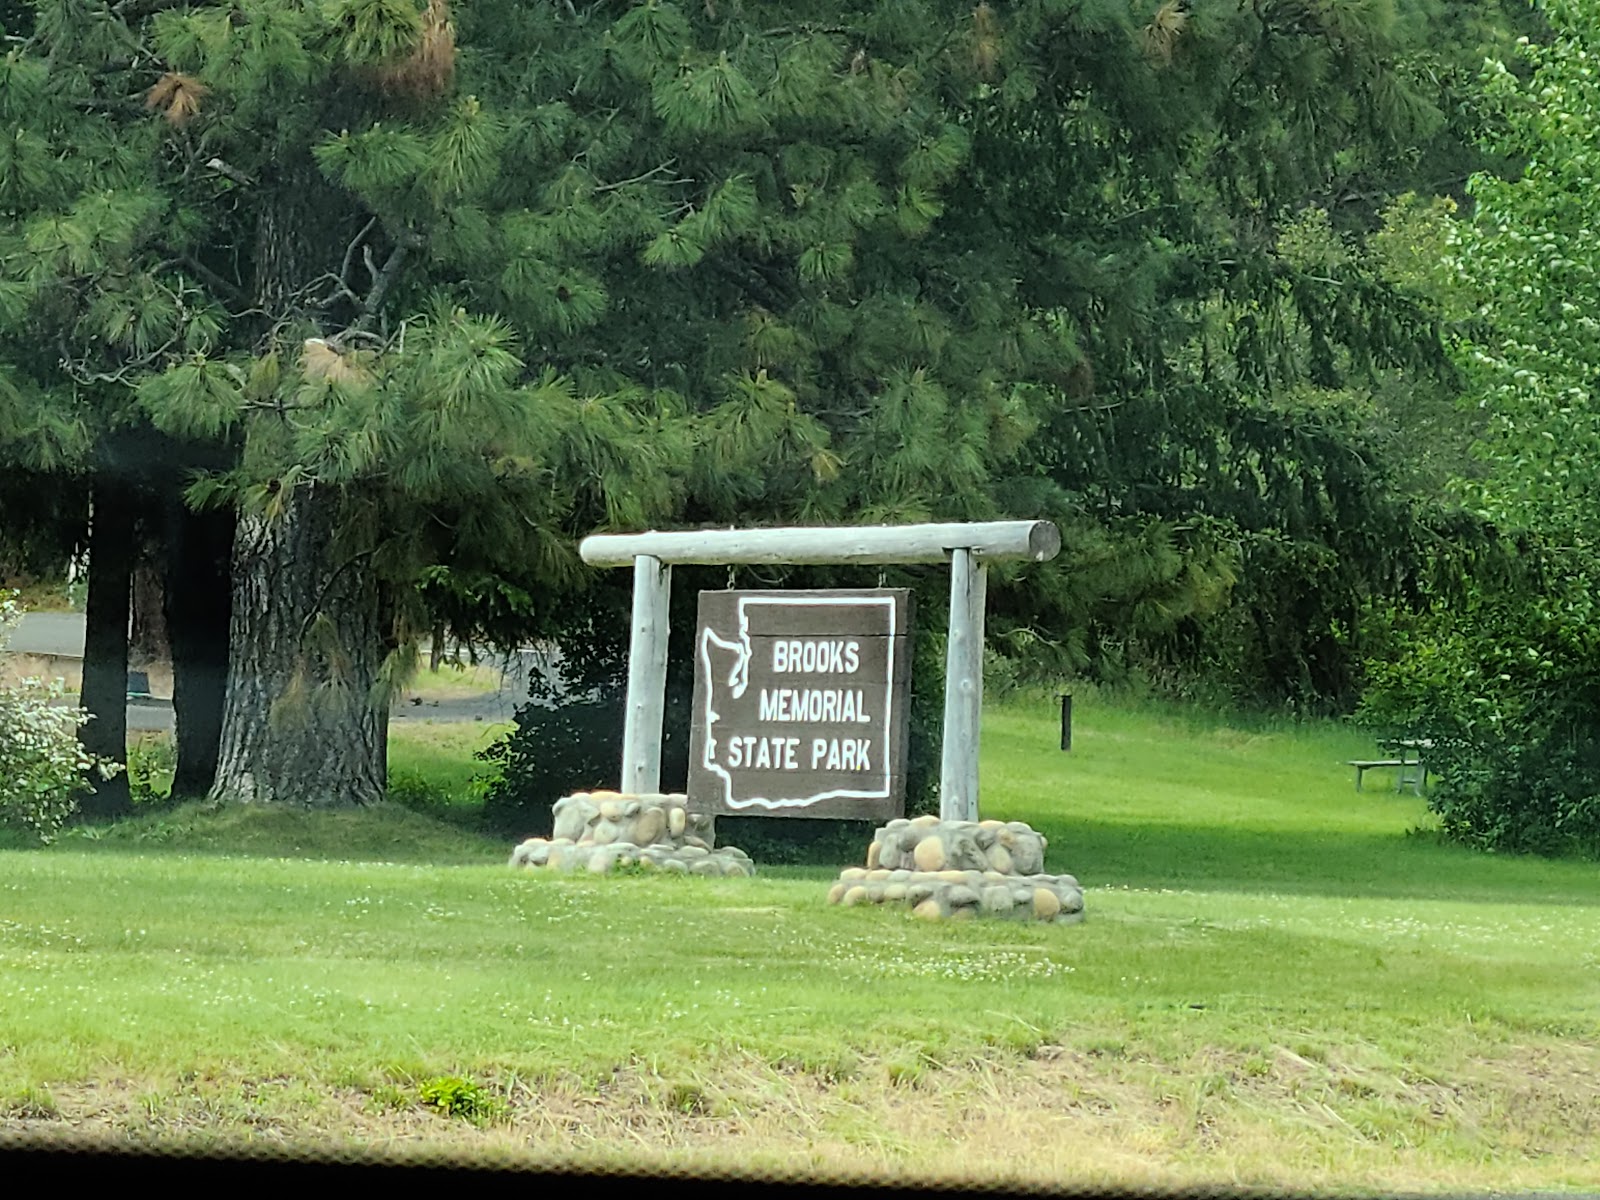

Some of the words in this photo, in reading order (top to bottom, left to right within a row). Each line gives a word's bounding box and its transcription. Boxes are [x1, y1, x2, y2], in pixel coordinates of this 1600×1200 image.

[772, 640, 860, 673] BROOKS
[758, 688, 871, 723] MEMORIAL
[728, 736, 801, 769] STATE
[811, 738, 871, 771] PARK
